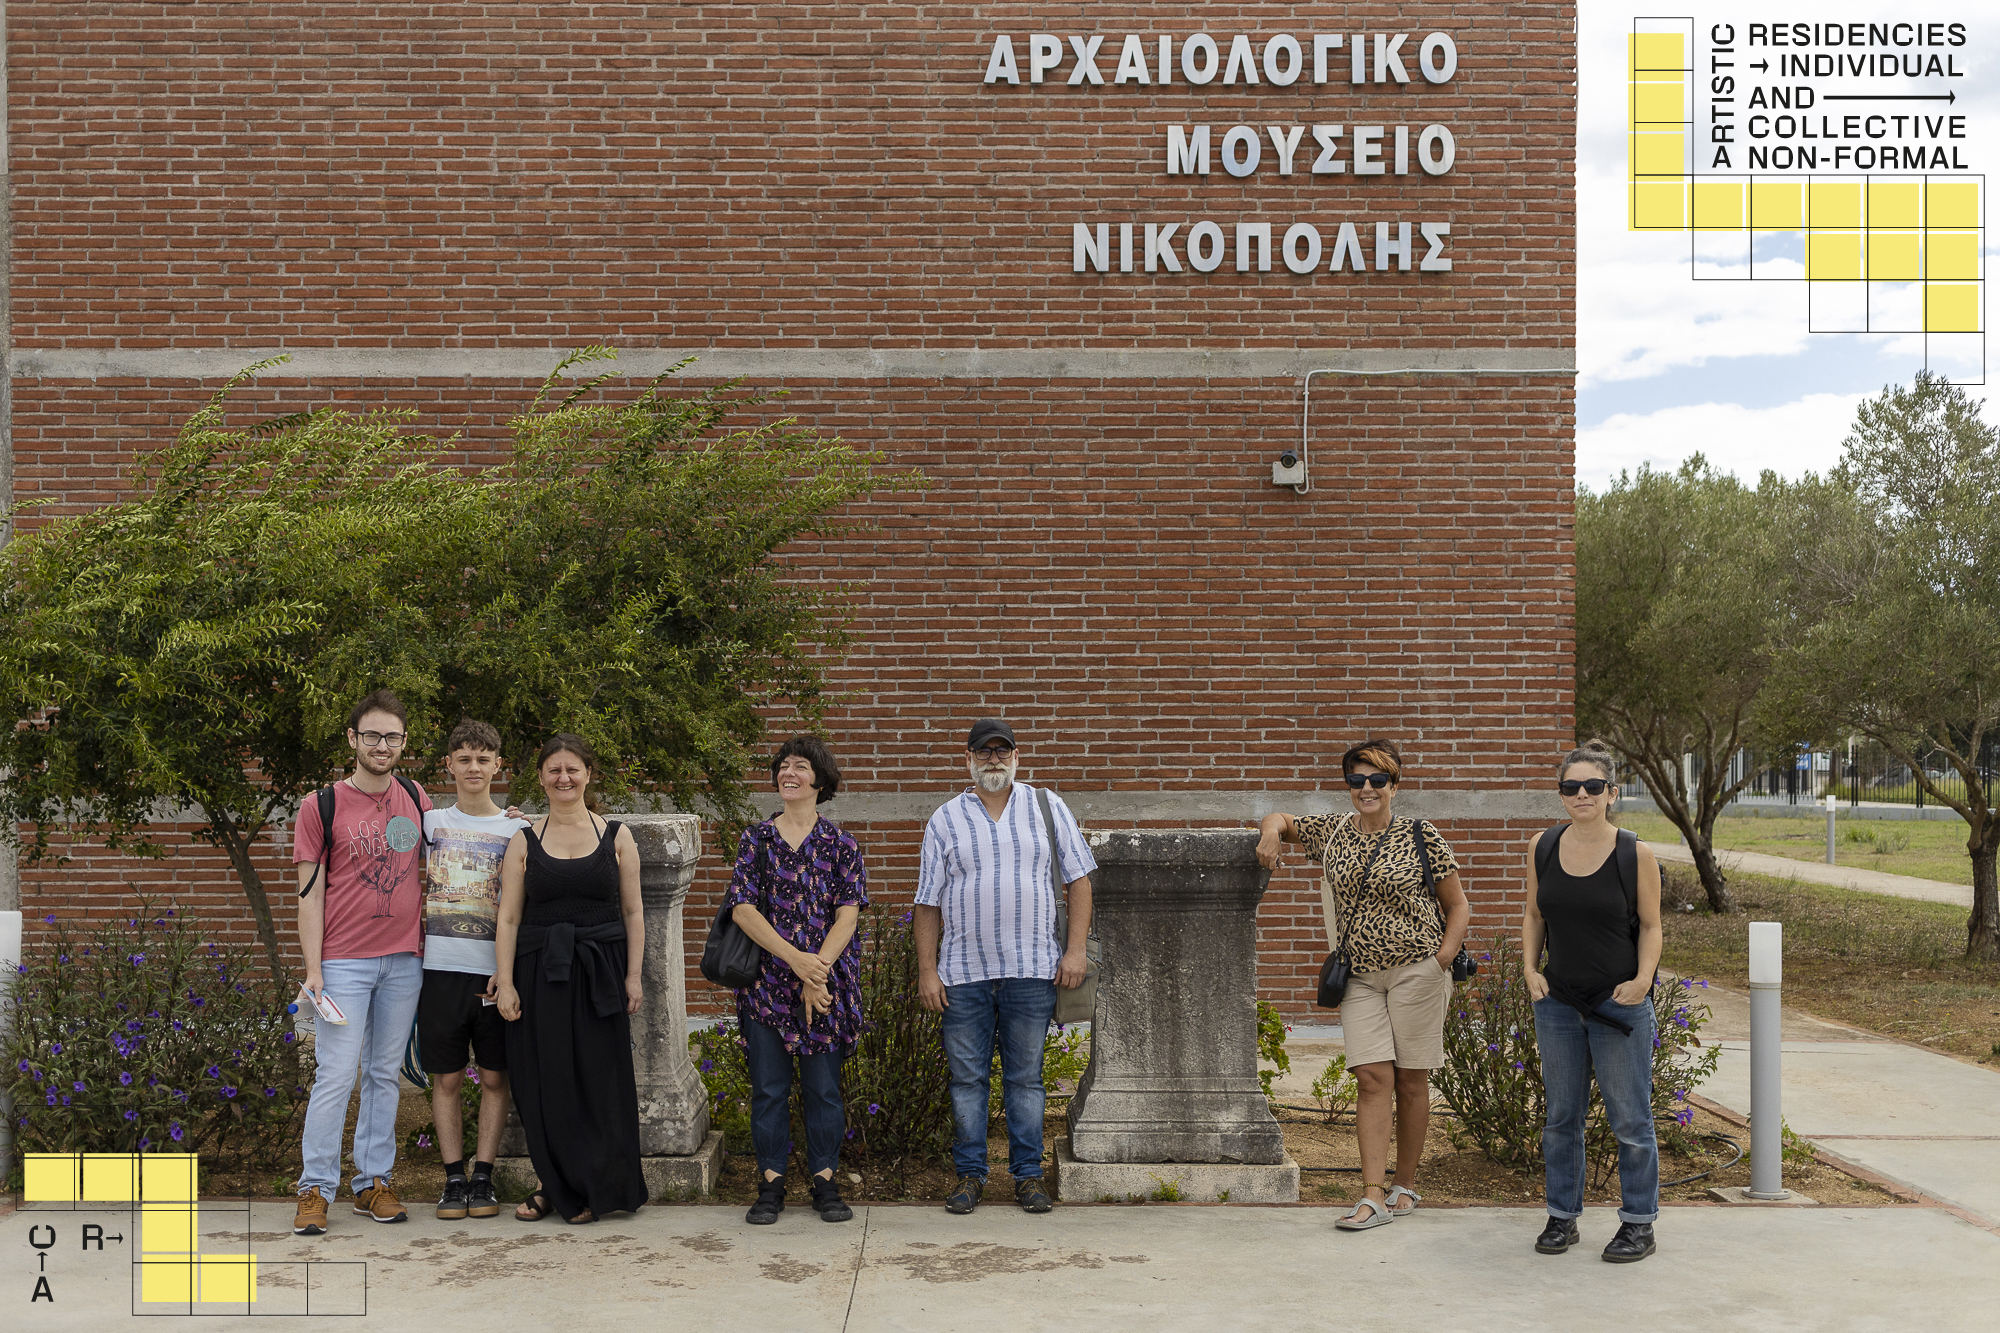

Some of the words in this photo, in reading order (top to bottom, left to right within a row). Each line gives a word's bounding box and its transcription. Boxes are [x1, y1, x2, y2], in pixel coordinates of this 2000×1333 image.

[983, 32, 1458, 86] ΑΡΧΑΙΟΛΟΓΙΚΟ
[1166, 124, 1456, 177] ΜΟΥΣΕΙΟ
[1073, 220, 1453, 274] ΝΙΚΟΠΟΛΗΣ
[347, 820, 380, 839] LOS
[349, 830, 417, 859] ANGELES
